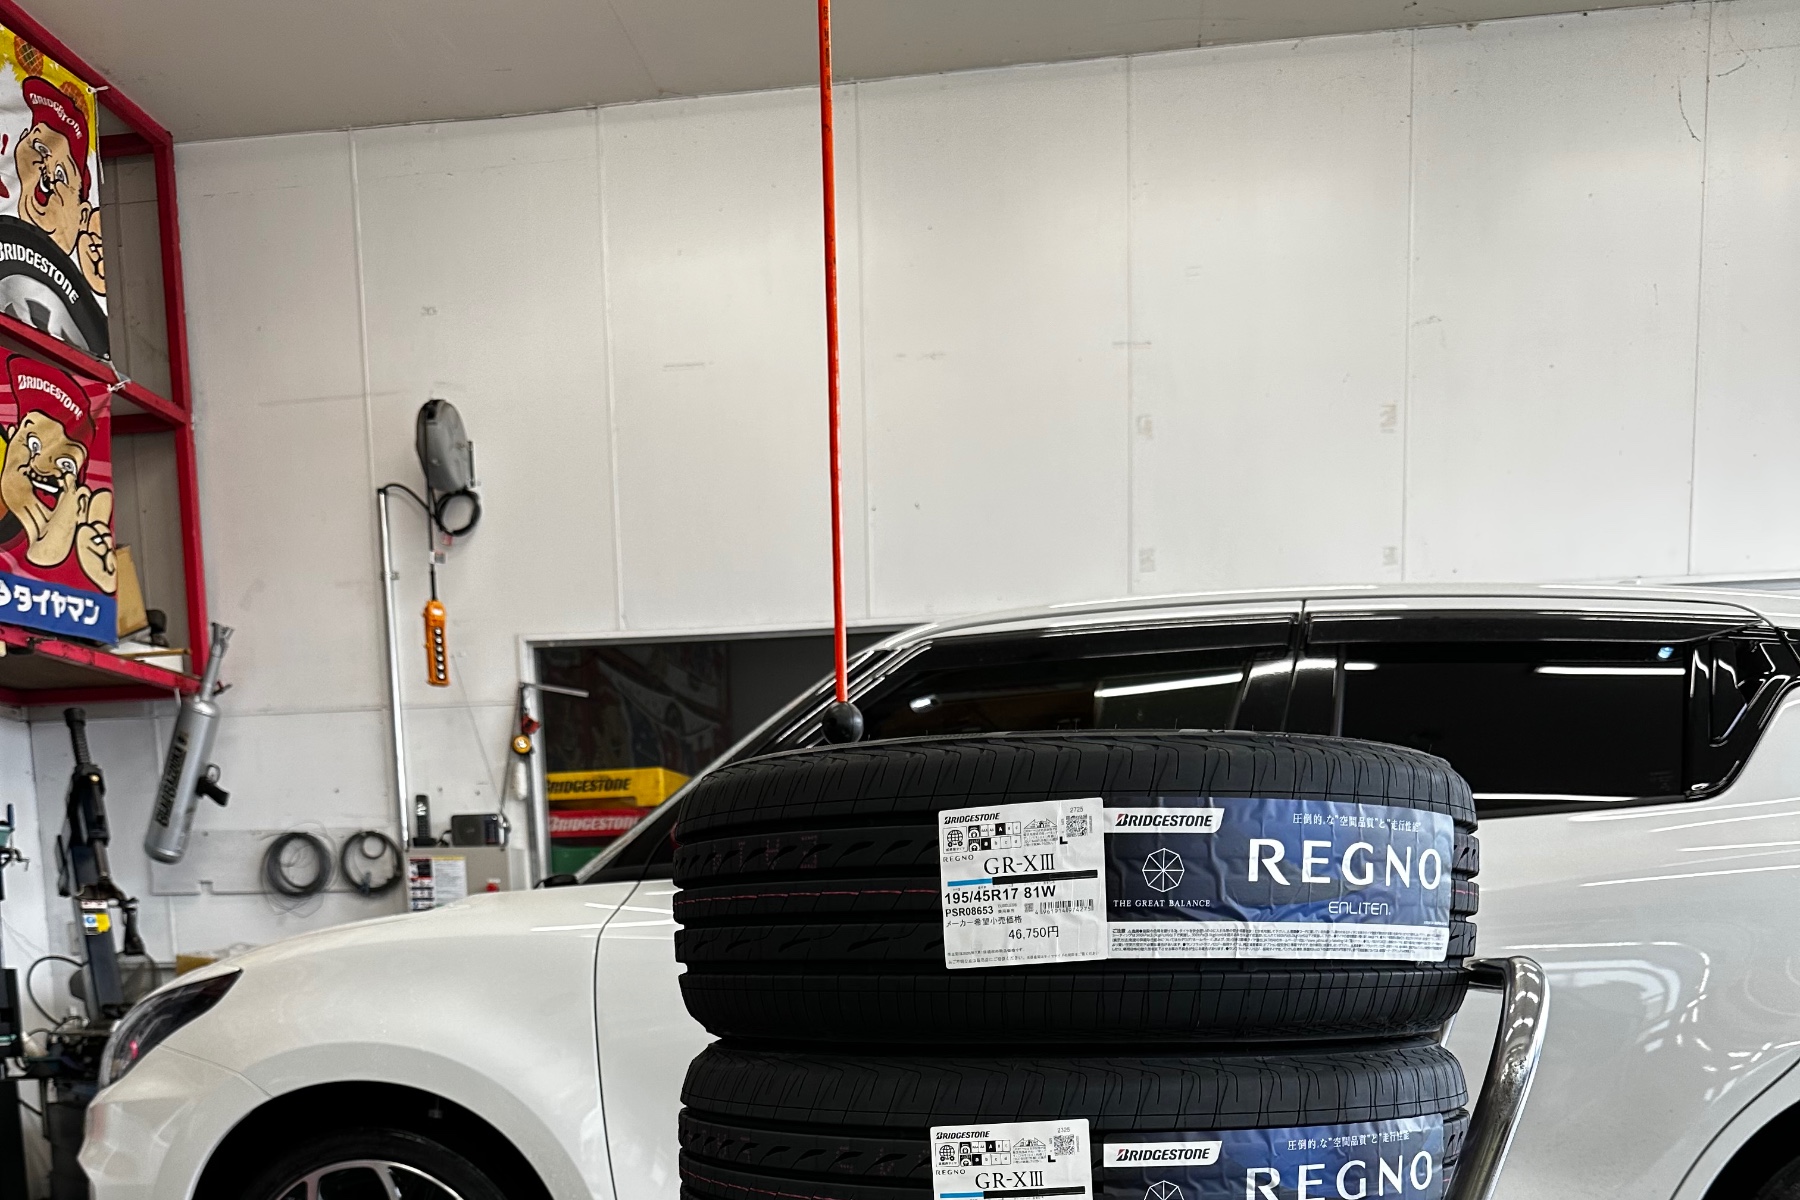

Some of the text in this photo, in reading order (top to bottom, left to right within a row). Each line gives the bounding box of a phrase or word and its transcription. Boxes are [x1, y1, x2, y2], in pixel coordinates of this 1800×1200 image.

[29, 92, 82, 140] BRIDGESTONE
[18, 374, 84, 420] BRIDGESTONE
[944, 813, 1000, 824] BRIDGESTONE
[1115, 814, 1213, 827] BRIDGESTONE
[1248, 839, 1441, 889] REGNO
[945, 886, 1055, 905] 195/45R17 81W
[946, 906, 994, 917] PSR08653
[946, 916, 1022, 927] メーカー希望小売価格
[936, 1131, 990, 1139] BRIDGESTONE
[1116, 1148, 1210, 1161] BRIDGESTONE
